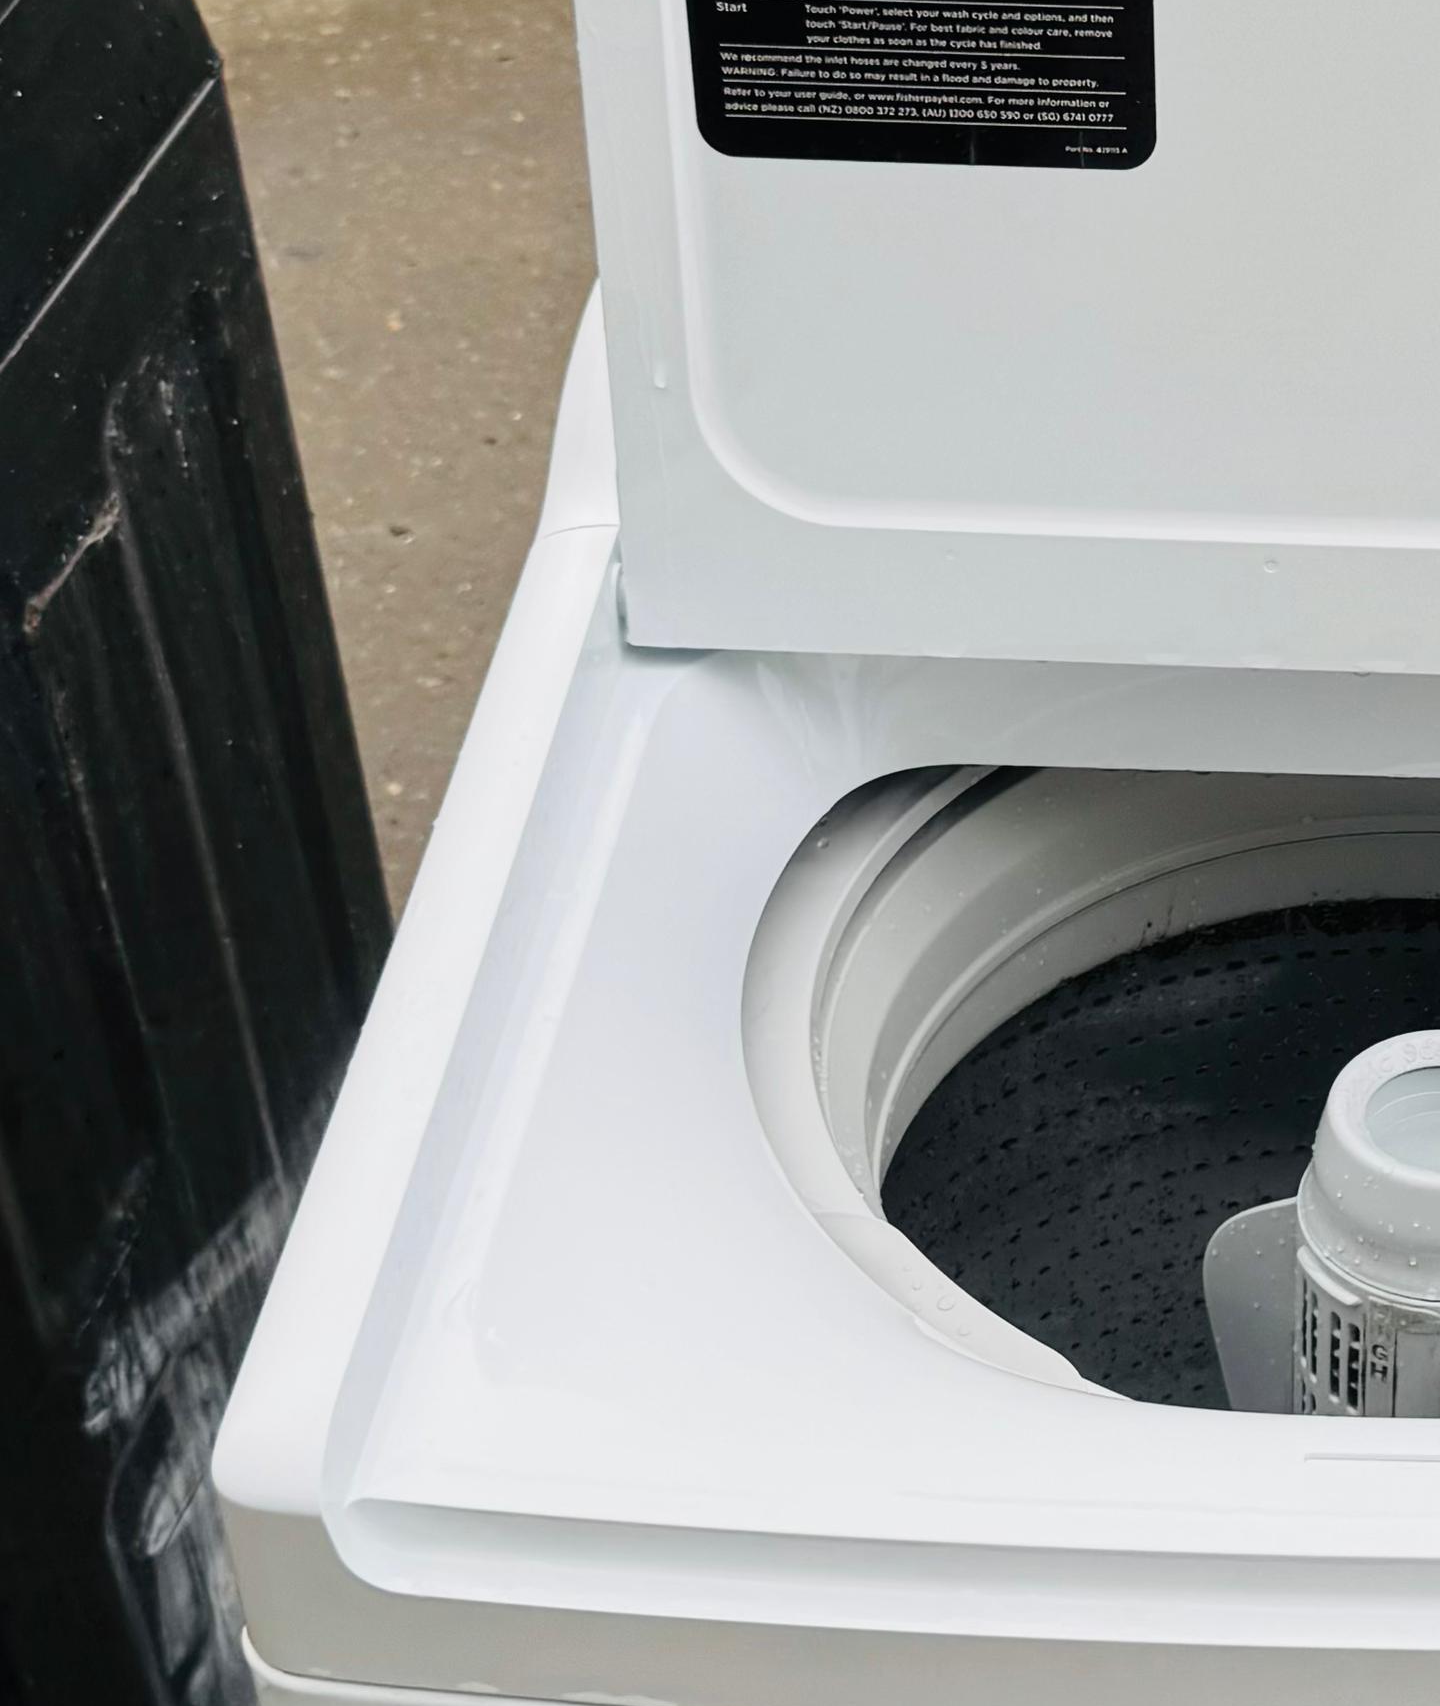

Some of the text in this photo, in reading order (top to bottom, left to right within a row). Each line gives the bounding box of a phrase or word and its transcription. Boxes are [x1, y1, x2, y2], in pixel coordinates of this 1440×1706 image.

[715, 1, 748, 12] Start
[804, 4, 837, 13] Touch
[882, 7, 914, 16] select
[915, 9, 940, 18] your
[941, 9, 970, 18] wash
[971, 10, 999, 20] cycle
[1001, 12, 1022, 20] and
[1067, 13, 1088, 22] and
[1089, 14, 1114, 23] then
[805, 19, 836, 28] touch
[909, 22, 928, 31] For
[804, 55, 823, 63] the
[824, 55, 848, 64] inlet
[849, 56, 881, 65] hoses
[882, 58, 900, 66] are
[901, 58, 948, 69] changed
[948, 60, 978, 70] every
[980, 60, 988, 69] 5
[723, 86, 752, 96] Refer
[767, 90, 792, 98] your
[987, 95, 1006, 105] For
[1007, 98, 1035, 106] more
[1036, 97, 1097, 107] information
[724, 102, 759, 110] advice
[760, 103, 795, 112] please
[796, 104, 816, 112] call
[817, 104, 843, 114] (NZ)
[844, 105, 875, 114] 0800
[876, 106, 896, 115] 372
[921, 108, 947, 118] (AU)
[948, 108, 975, 118] 1300
[976, 109, 998, 118] 650
[999, 110, 1021, 119] 590
[1037, 111, 1061, 121] (SG)
[1062, 112, 1086, 121] 6741
[1087, 113, 1114, 122] 0777
